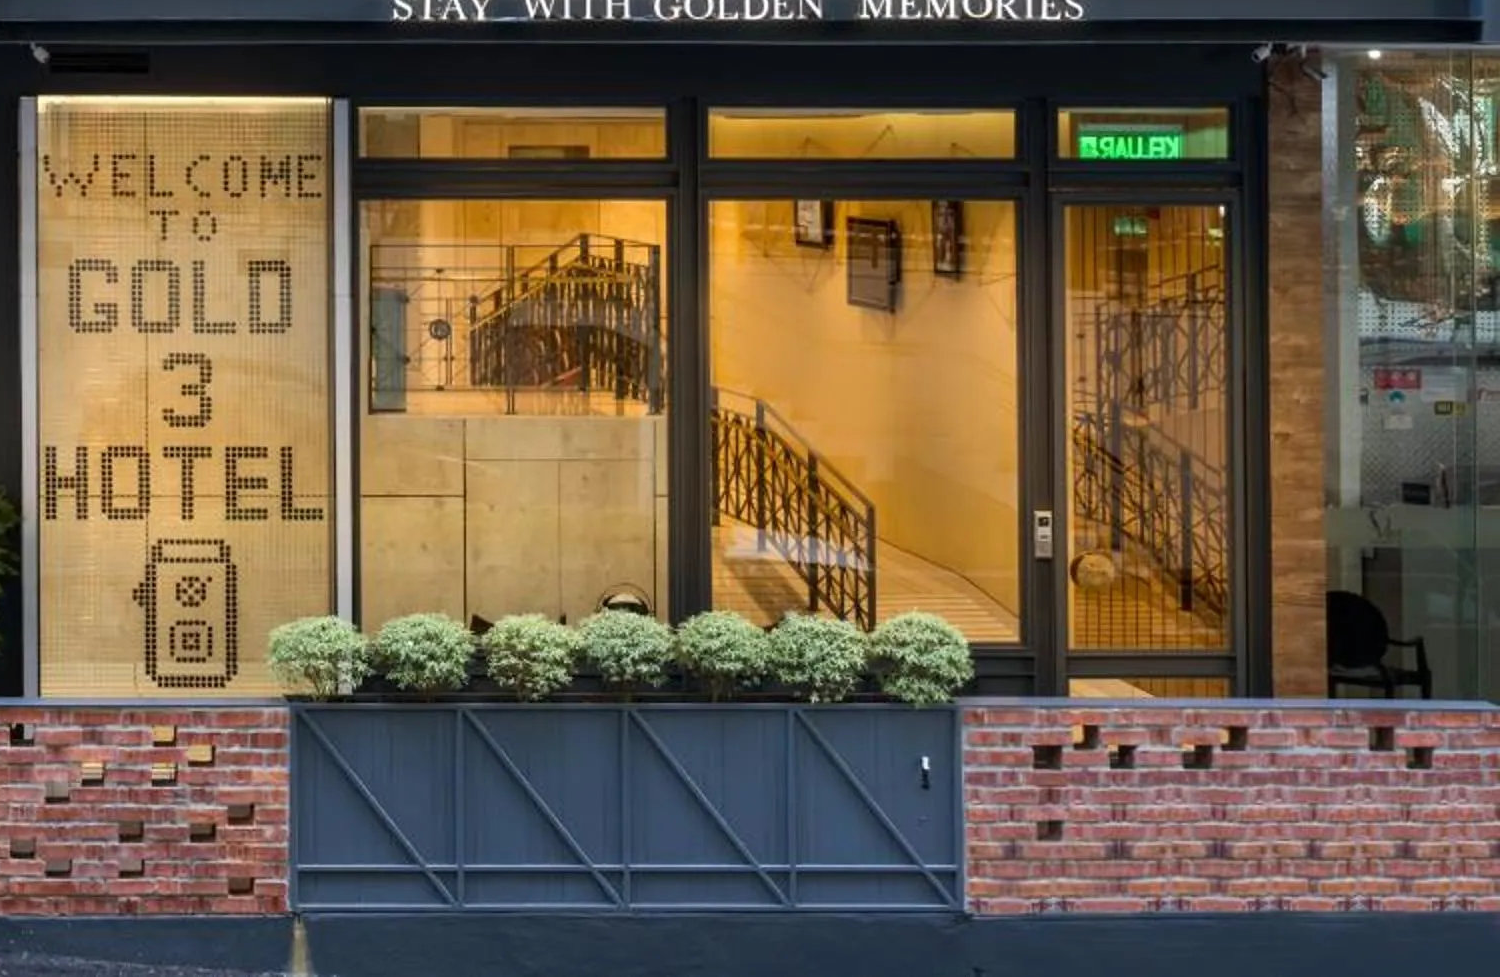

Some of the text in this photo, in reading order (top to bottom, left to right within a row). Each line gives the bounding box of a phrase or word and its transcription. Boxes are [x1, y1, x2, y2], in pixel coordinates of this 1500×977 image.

[43, 153, 323, 198] WELCOME
[149, 209, 217, 241] TO
[68, 259, 293, 335] GOLD
[162, 352, 213, 428] 3
[45, 446, 324, 521] HOTEL
